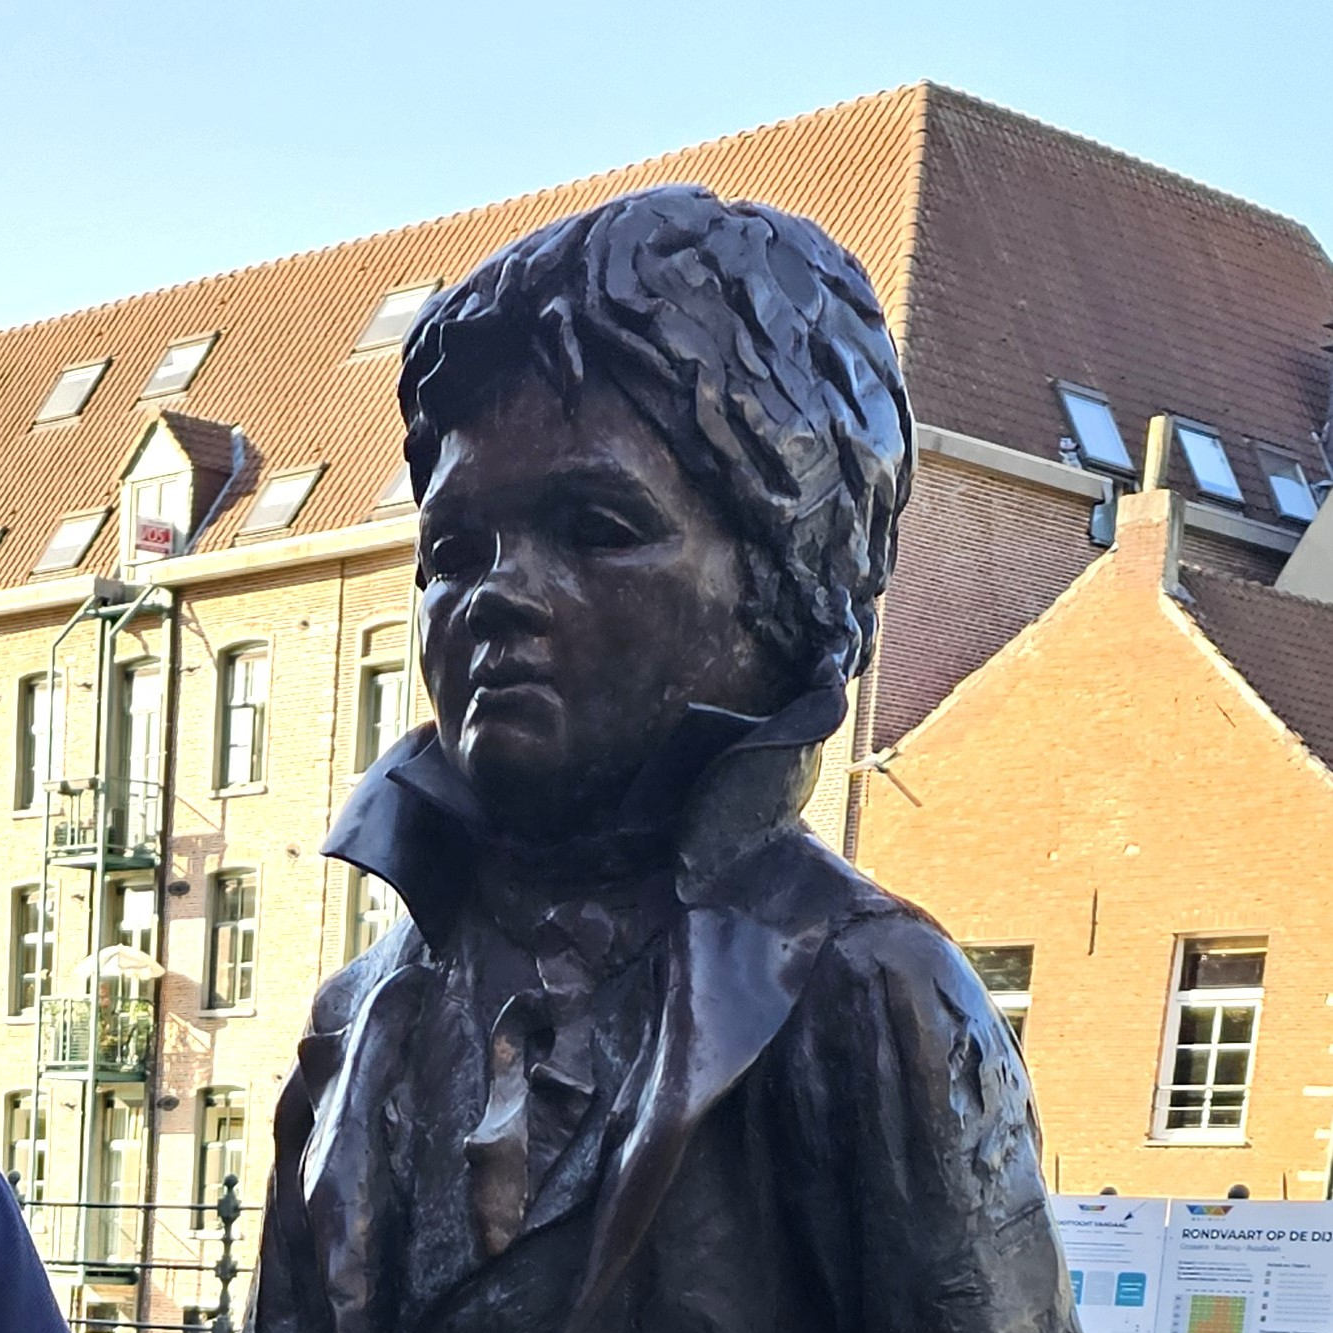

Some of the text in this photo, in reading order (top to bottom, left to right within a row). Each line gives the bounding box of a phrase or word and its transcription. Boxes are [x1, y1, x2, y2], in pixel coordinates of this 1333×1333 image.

[1181, 1228, 1263, 1240] RONDVAART
[1266, 1230, 1286, 1241] OP
[1289, 1231, 1308, 1242] DE
